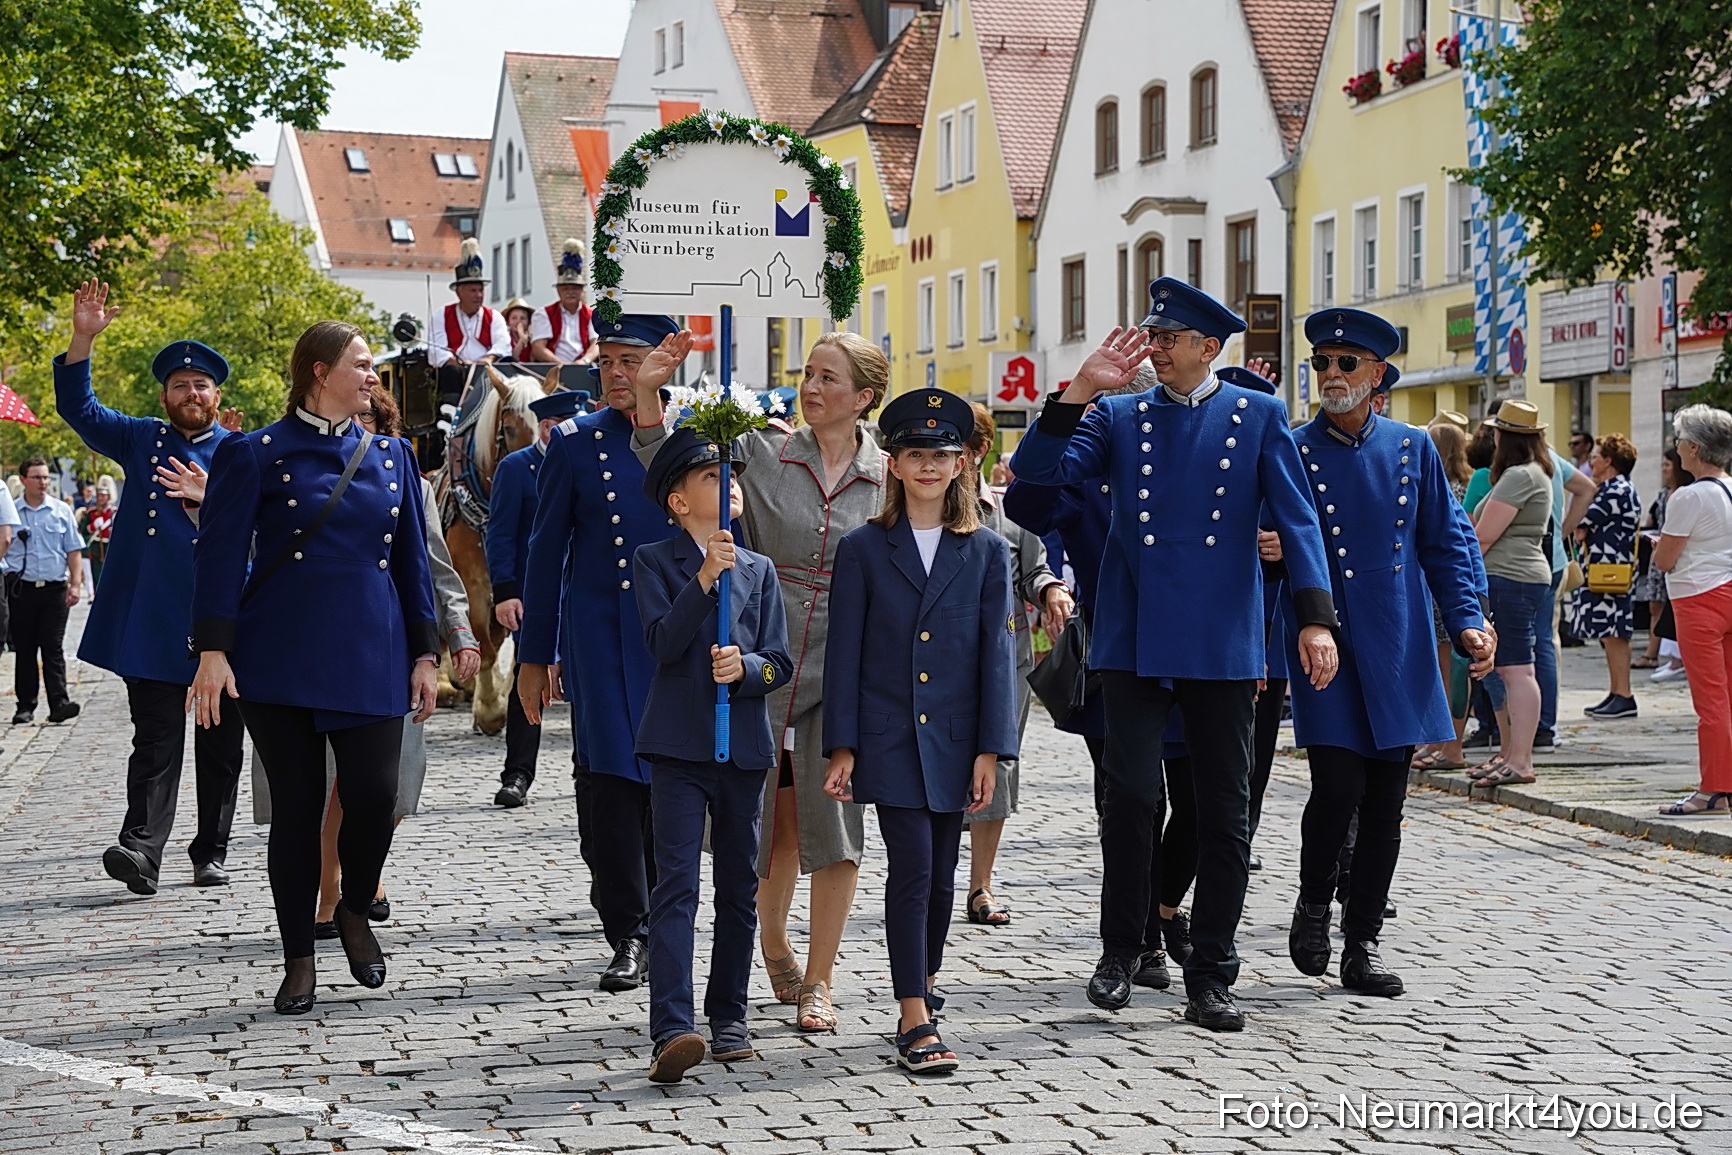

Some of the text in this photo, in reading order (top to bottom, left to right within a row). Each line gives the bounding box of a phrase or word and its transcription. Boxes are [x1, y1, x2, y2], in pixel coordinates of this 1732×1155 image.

[628, 197, 741, 215] Museum für
[626, 217, 770, 237] Kommunikation
[626, 238, 715, 261] Nürnberg
[1614, 285, 1626, 367] KINO
